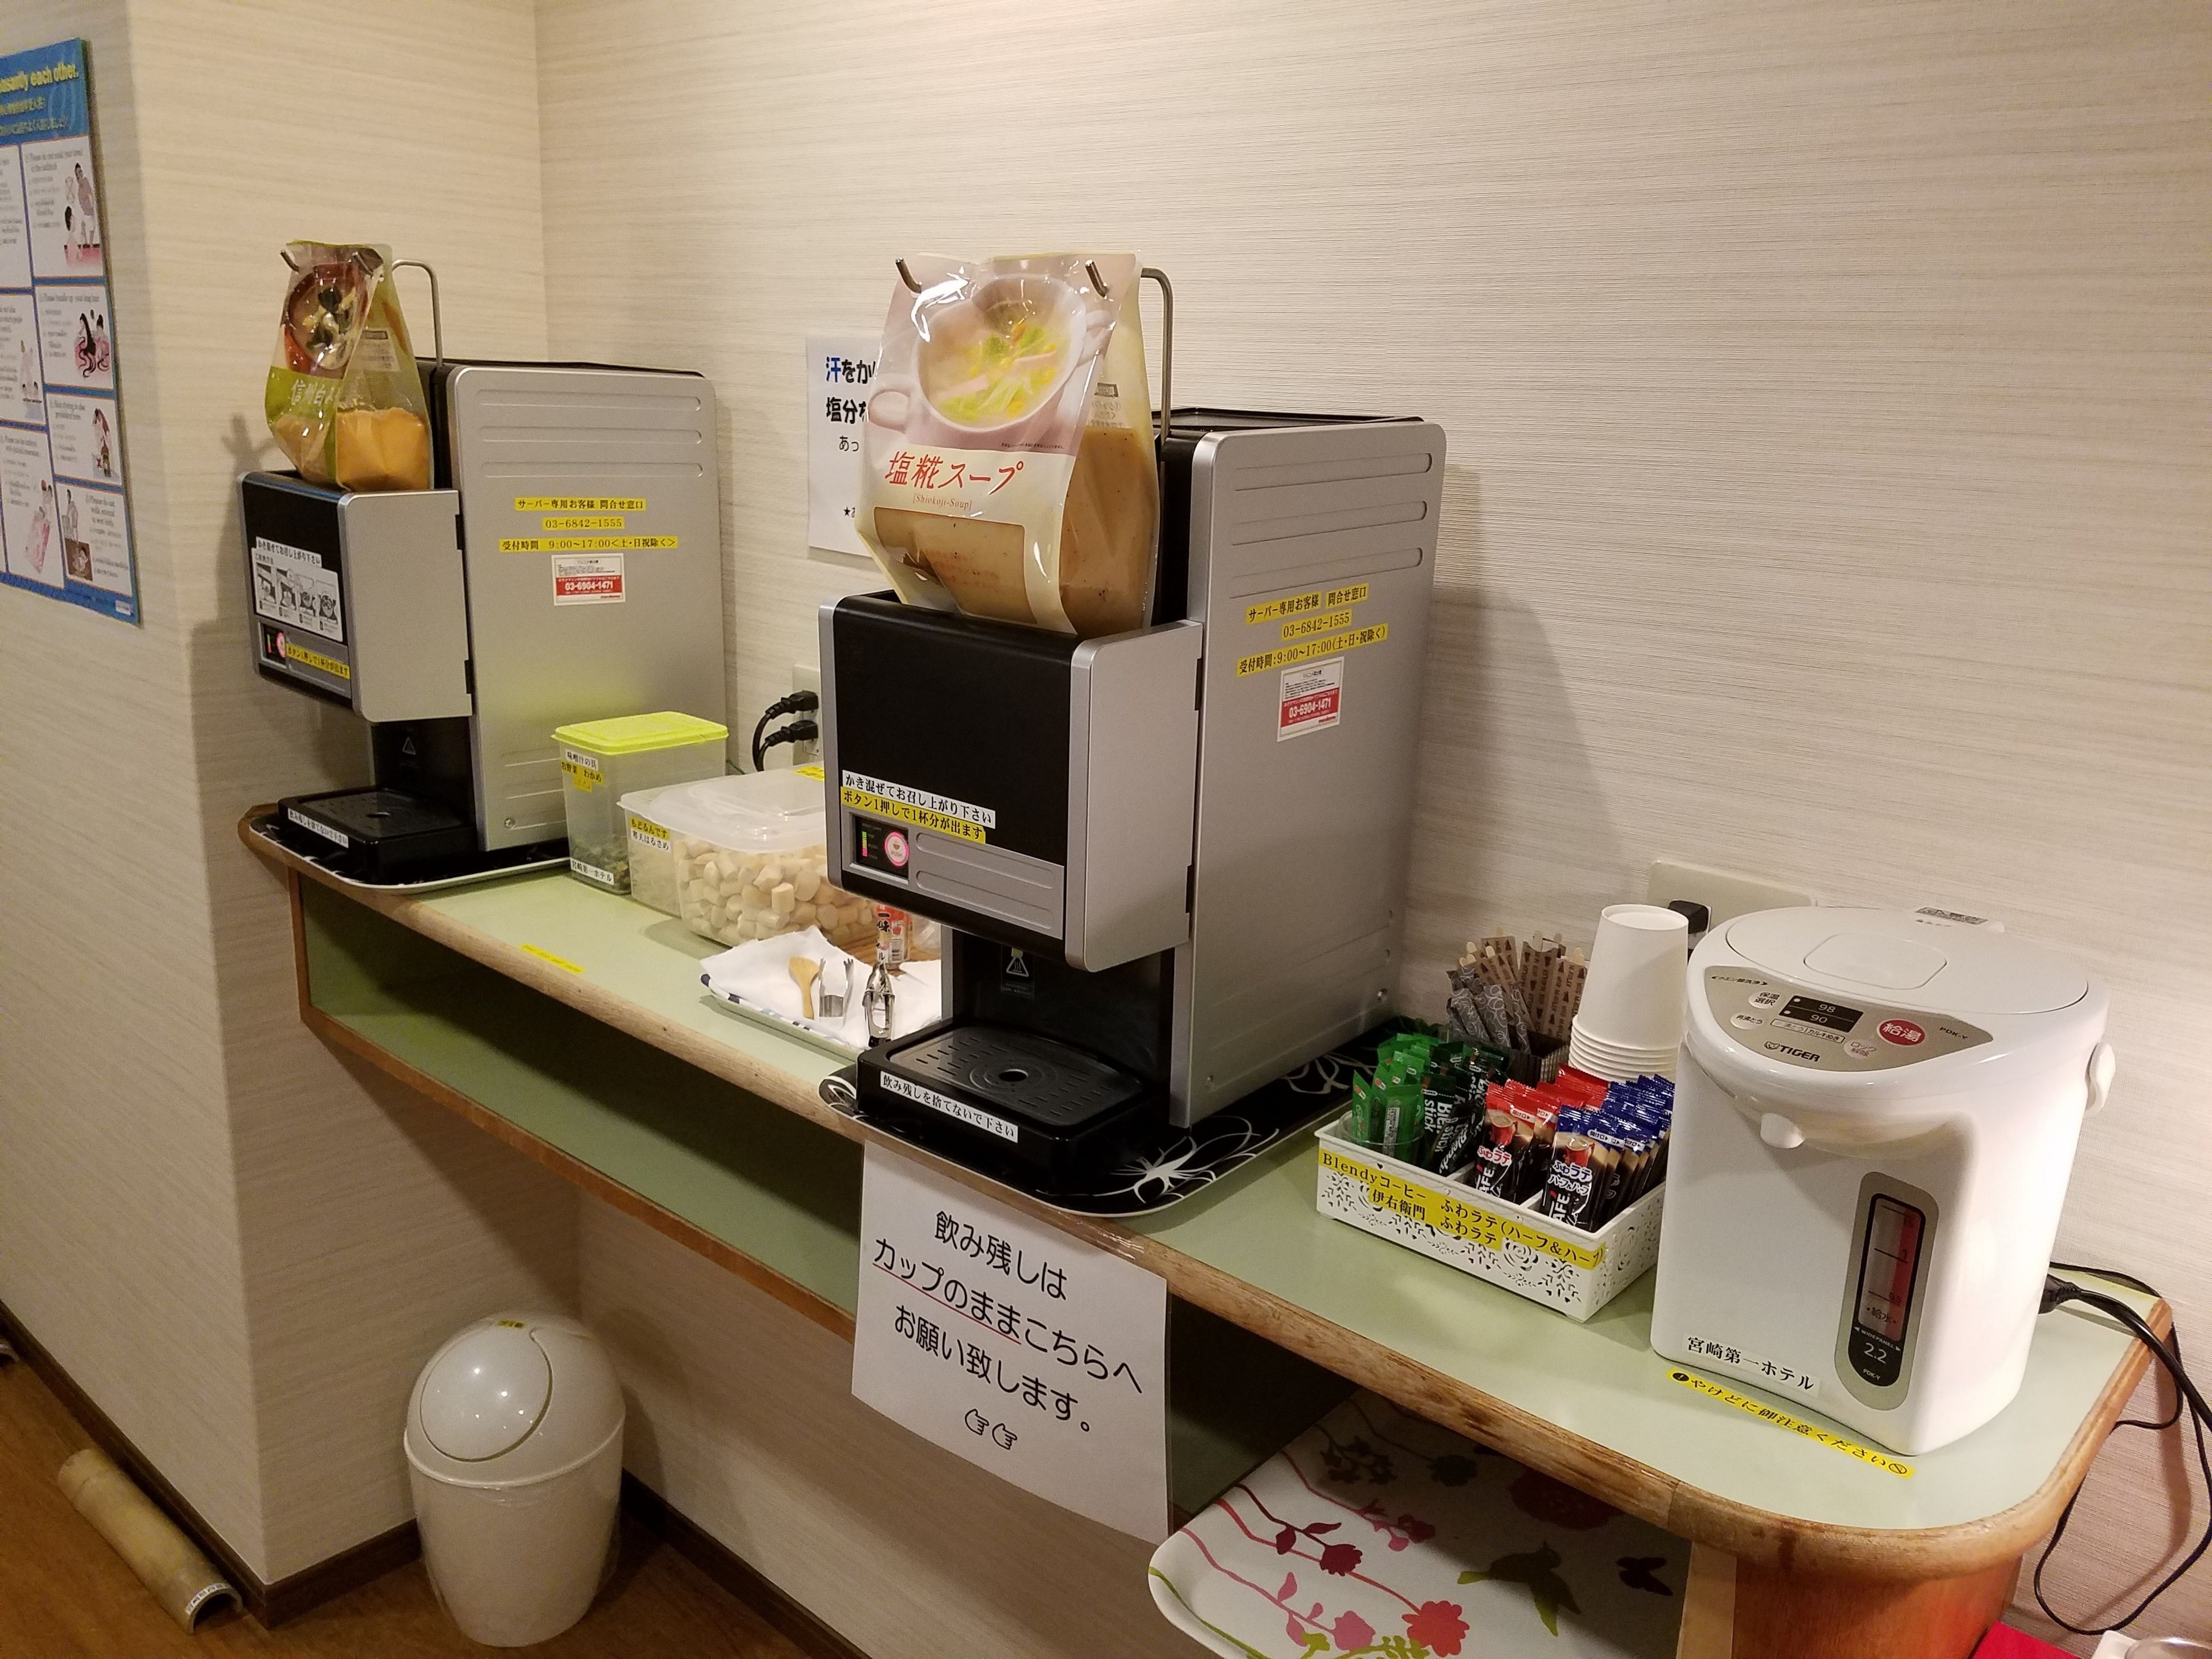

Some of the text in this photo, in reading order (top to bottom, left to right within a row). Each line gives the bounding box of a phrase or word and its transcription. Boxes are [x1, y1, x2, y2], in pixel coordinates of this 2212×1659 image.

[885, 451, 1024, 495] 塩糀スープ
[545, 518, 622, 529] 03-6842-1555
[1283, 612, 1350, 638] 03-6842-1555
[845, 774, 991, 824] かき混ぜてお召し上がり下さい
[1810, 1014, 1828, 1024] 90
[1818, 1004, 1836, 1013] 98
[1883, 1022, 1922, 1043] 給湯
[1939, 1027, 1969, 1040] PDK-Y
[1779, 1044, 1821, 1062] TIGER
[882, 1074, 1014, 1138] 飲み残しを捨てないで下さい
[1372, 1191, 1498, 1246] 伊右衛門 ふわラテ
[934, 1210, 1067, 1301] 飲み残しは
[874, 1238, 1142, 1393] カップのままこちらへ
[1687, 1336, 1815, 1391] 宮崎第一ホテル
[1863, 1342, 1887, 1365] 2.2
[895, 1305, 1090, 1432] お願い致します。
[1862, 1368, 1881, 1381] PDK-Y
